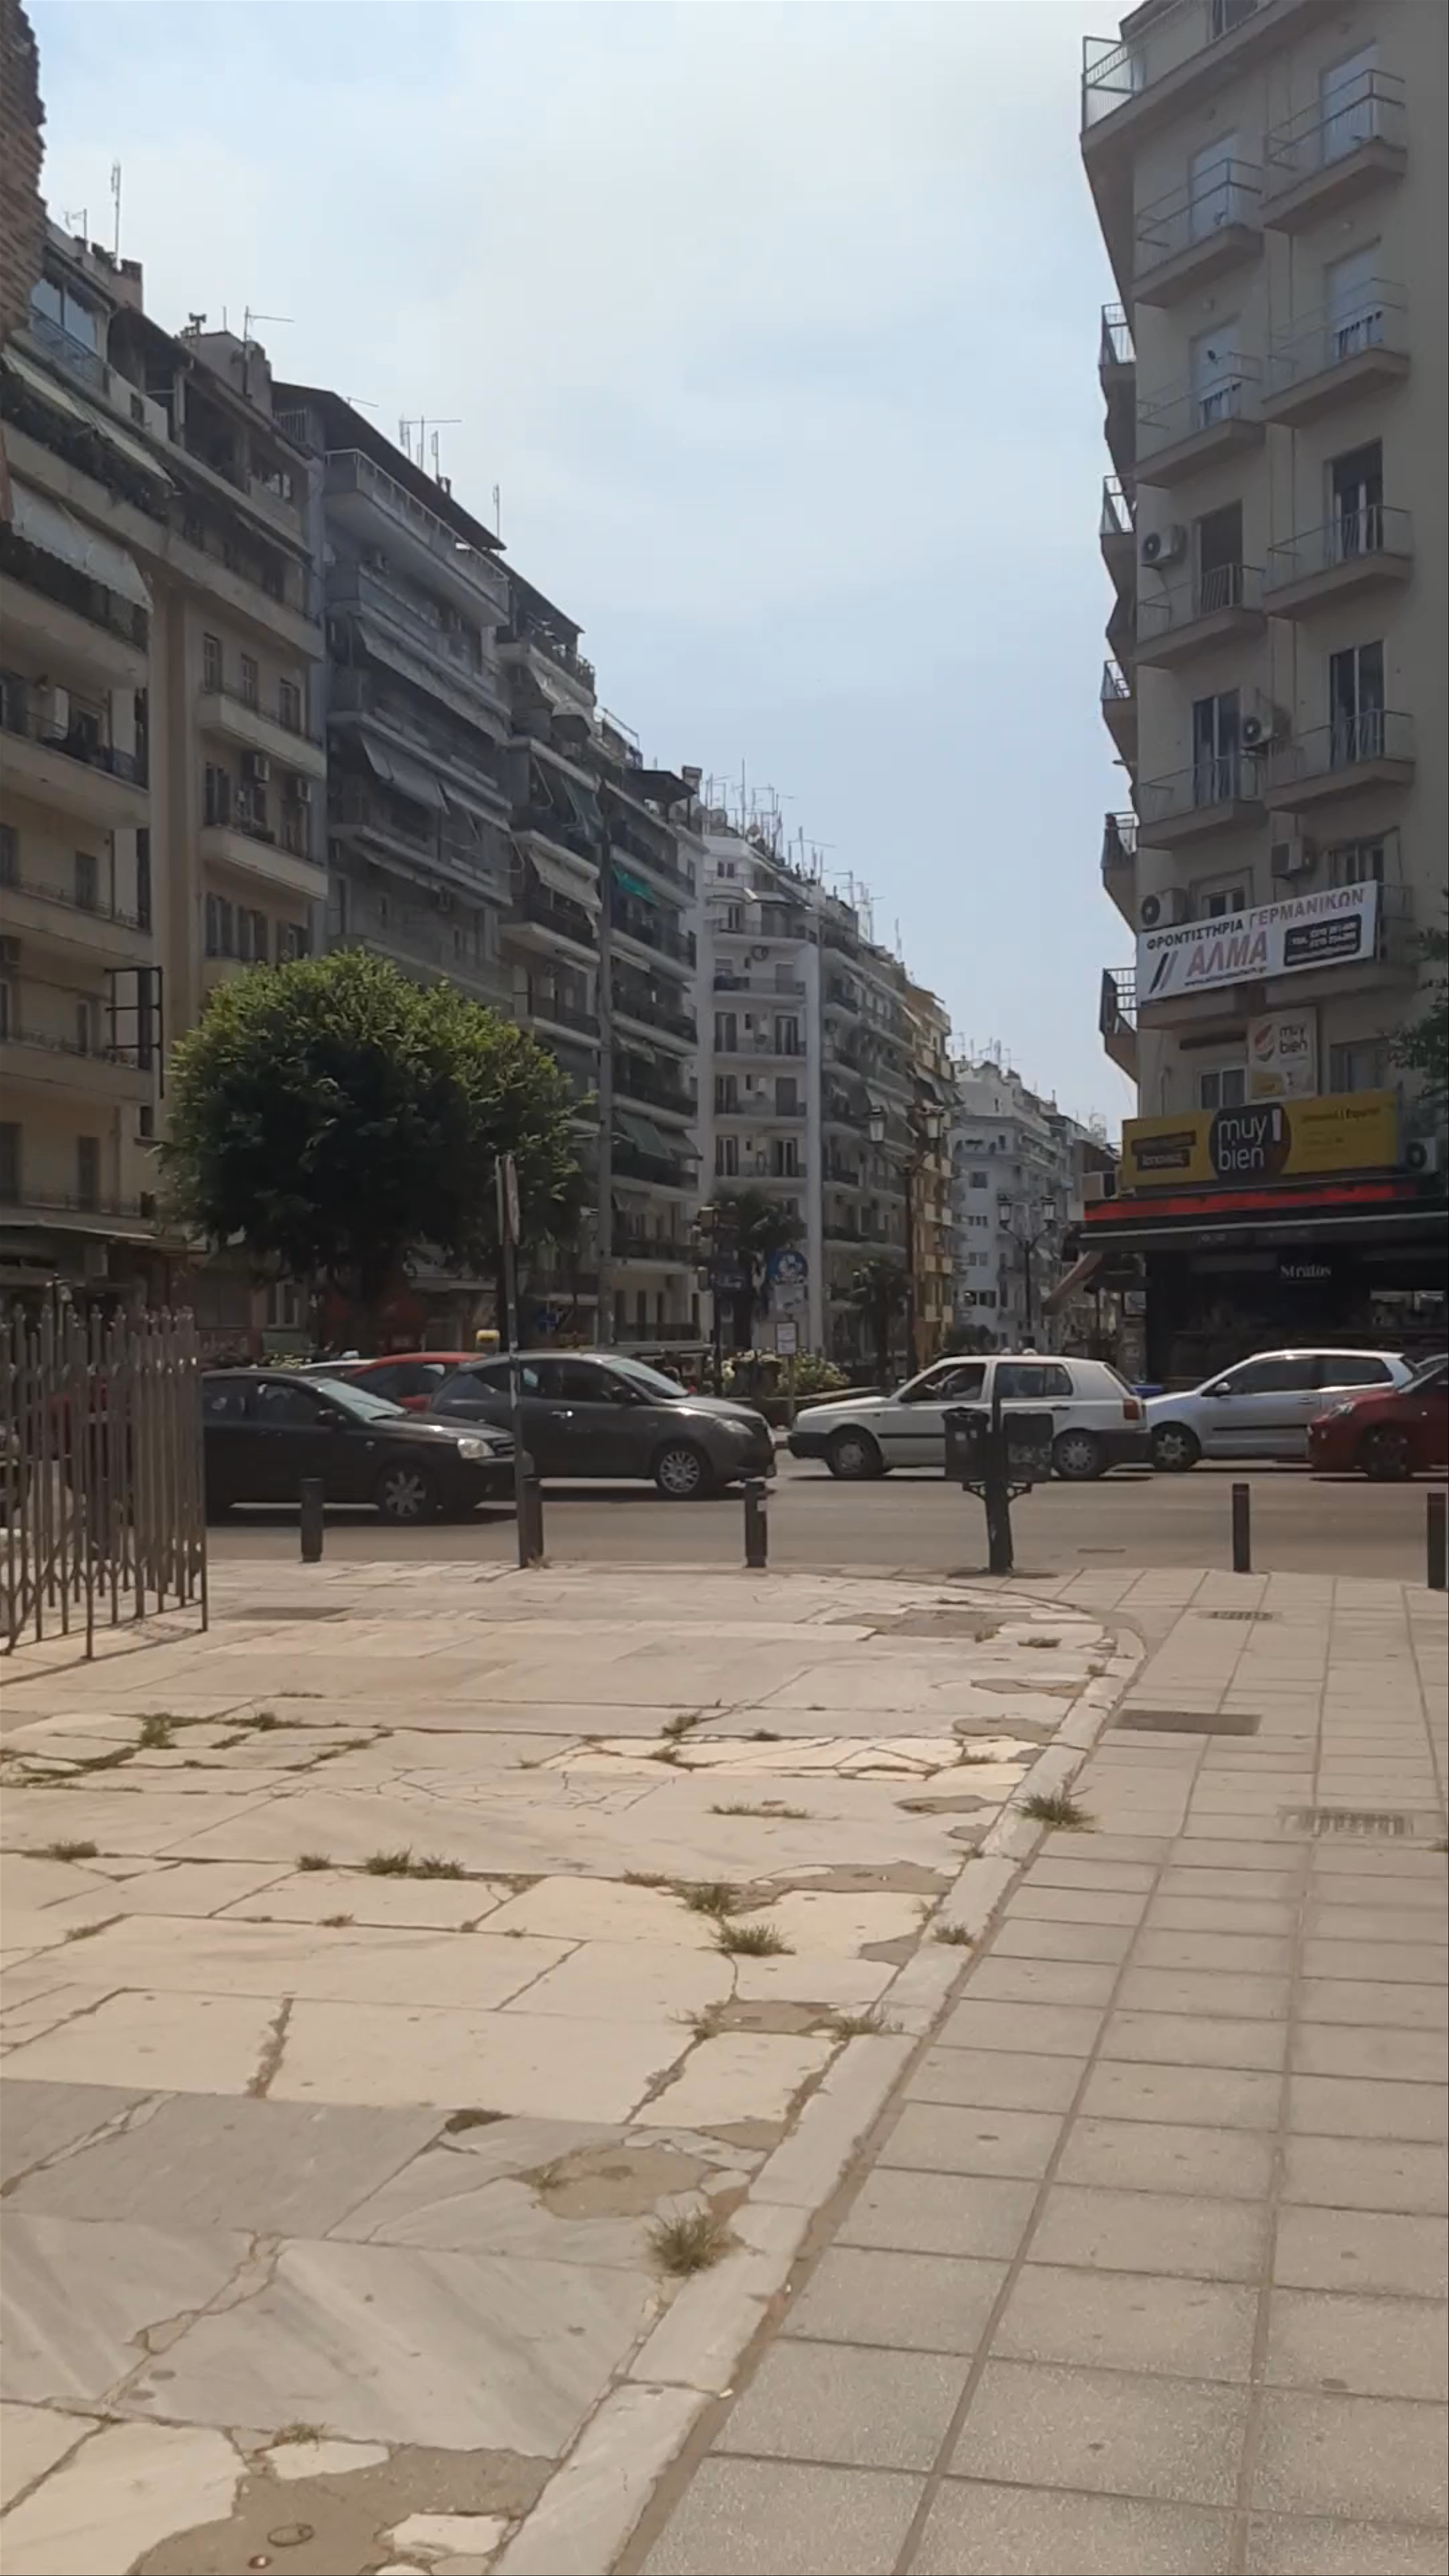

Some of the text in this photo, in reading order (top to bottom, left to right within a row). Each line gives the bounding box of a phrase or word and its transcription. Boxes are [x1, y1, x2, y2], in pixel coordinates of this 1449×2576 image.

[1146, 888, 1364, 950] ΦΡΟΝΤΙΣΤΗΡΙΑ ΓΕΡΜΑΝΙΚΩΝ
[1186, 930, 1267, 977] ΑΛΜΑ
[1280, 1023, 1306, 1040] muy
[1280, 1040, 1308, 1054] bien
[1218, 1115, 1267, 1146] muy
[1218, 1139, 1264, 1171] bien
